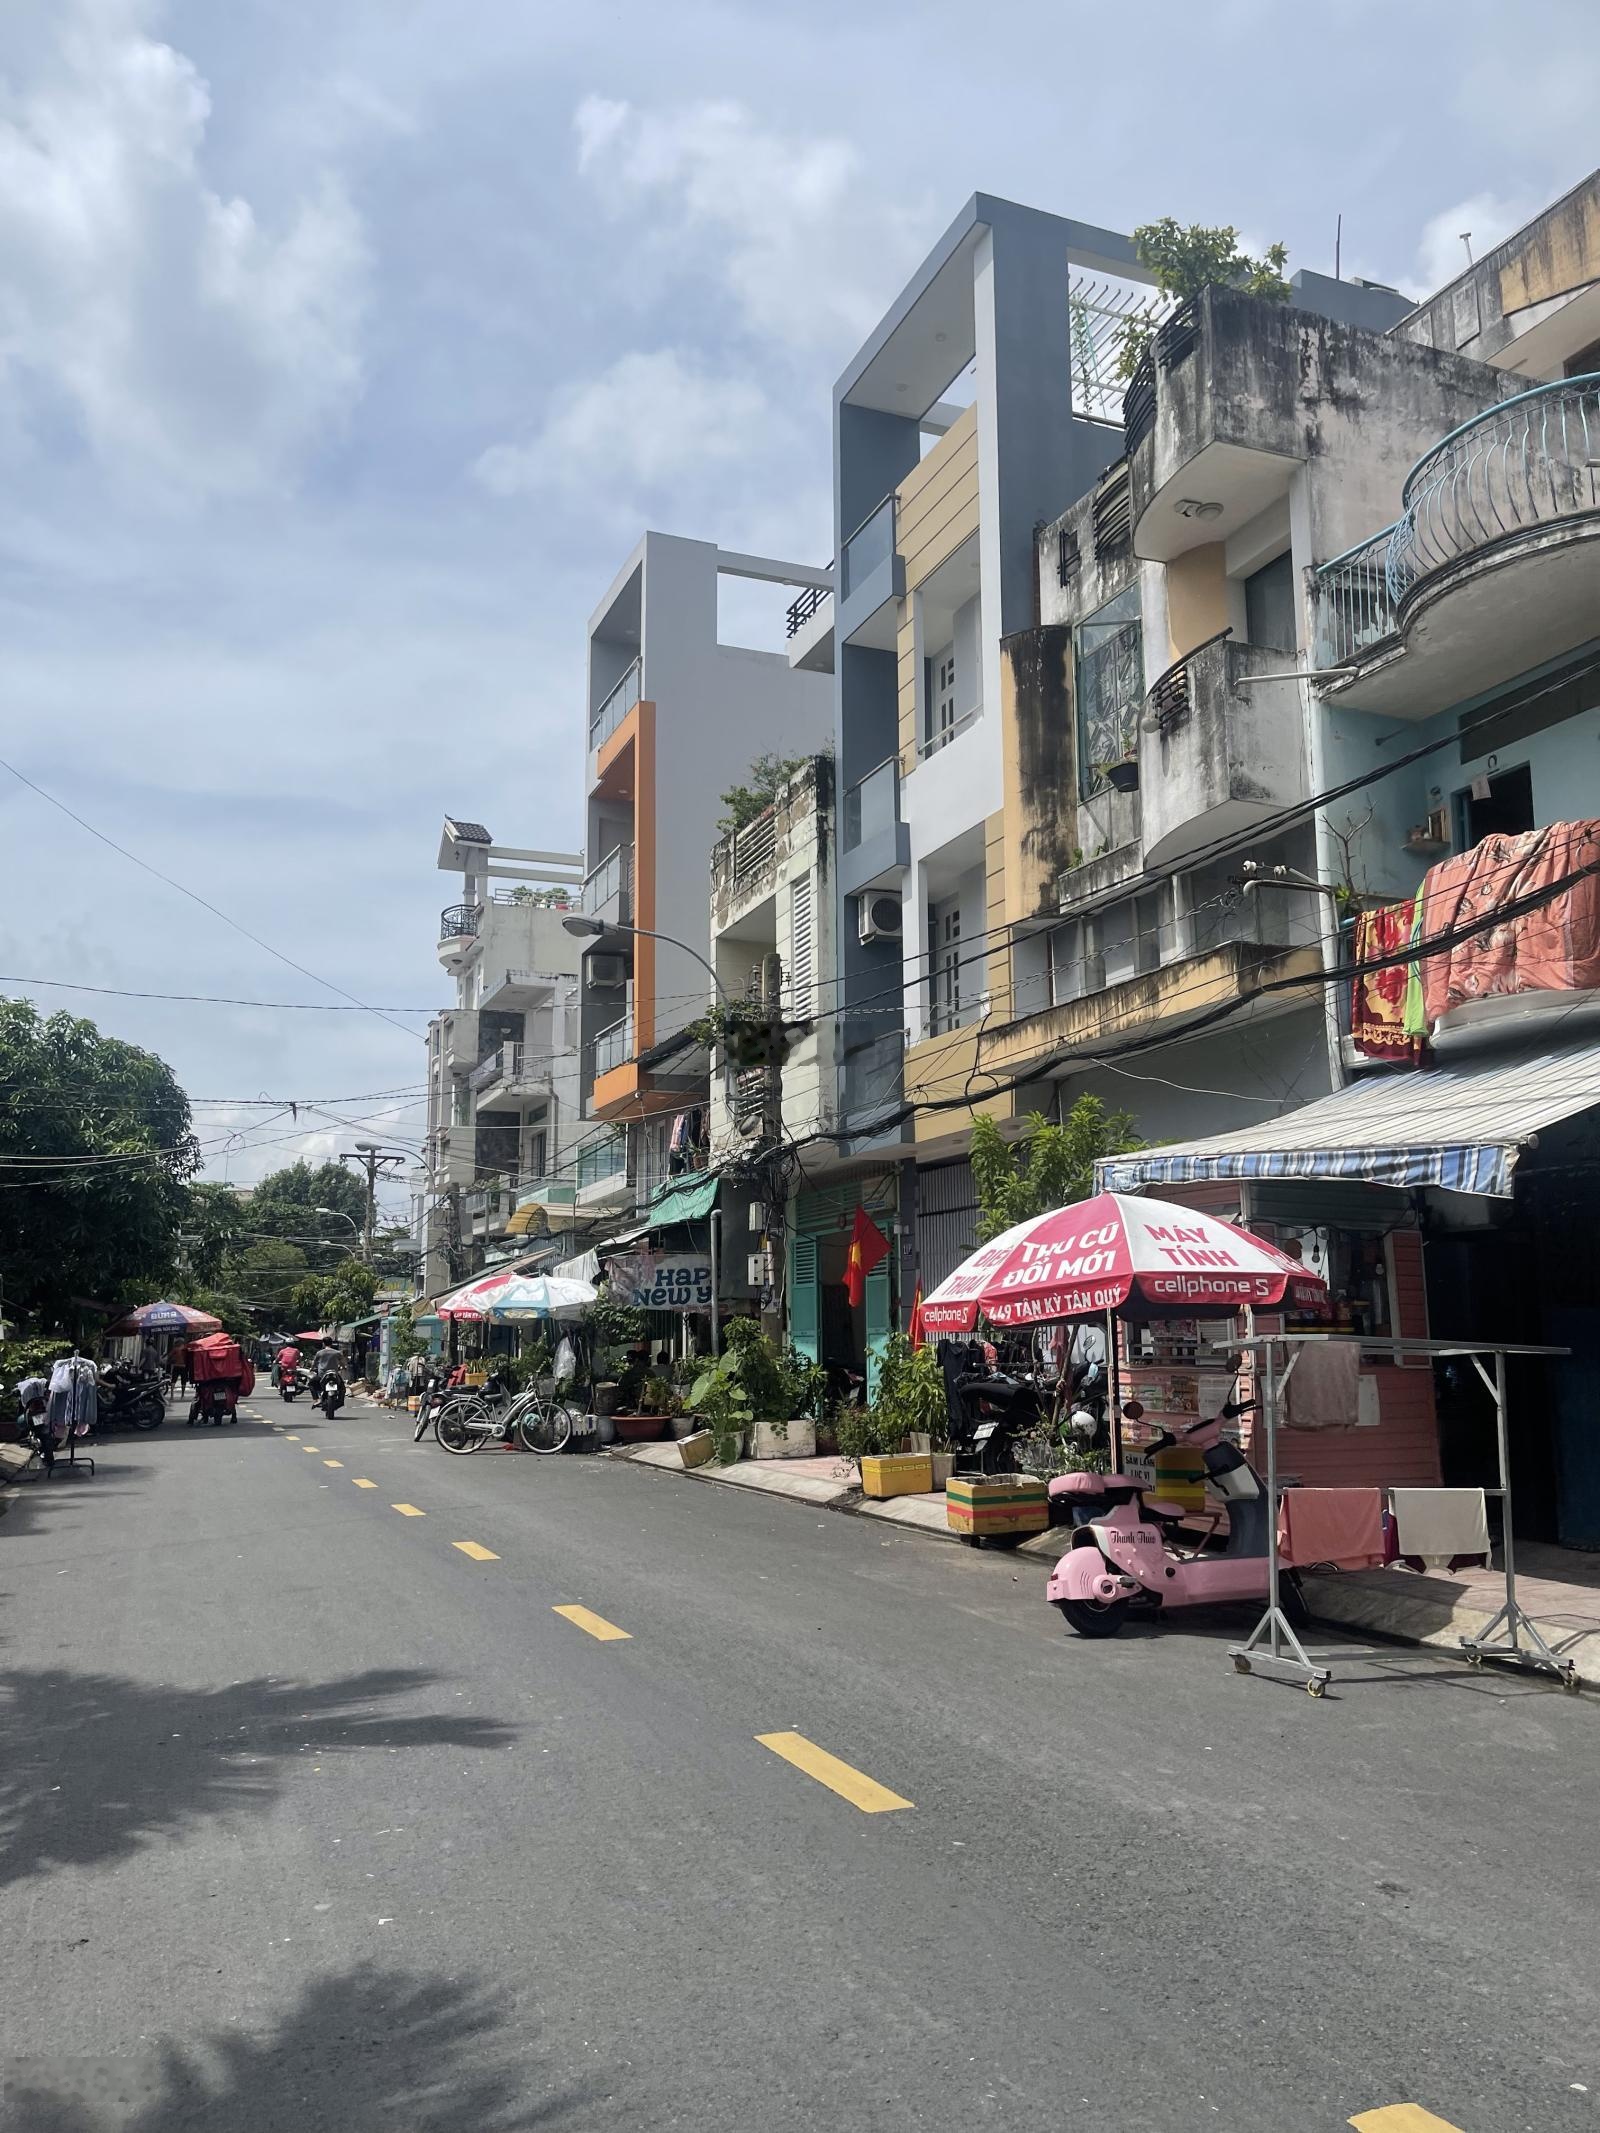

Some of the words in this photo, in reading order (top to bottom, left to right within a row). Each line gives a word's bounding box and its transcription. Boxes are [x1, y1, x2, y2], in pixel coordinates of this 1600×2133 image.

[1022, 1235, 1076, 1262] THU
[1079, 1221, 1119, 1248] CŨ
[1143, 1225, 1210, 1243] MÁY
[1001, 1257, 1053, 1288] ĐỔI
[1056, 1249, 1116, 1280] MỚI
[1158, 1245, 1240, 1267] TÍNH
[941, 1273, 992, 1297] THOẠI
[988, 1304, 1012, 1320] 449
[1014, 1297, 1042, 1317] TÂN
[1045, 1293, 1062, 1313] KỲ
[1064, 1290, 1091, 1310] TÂN
[1095, 1284, 1121, 1305] QUÝ
